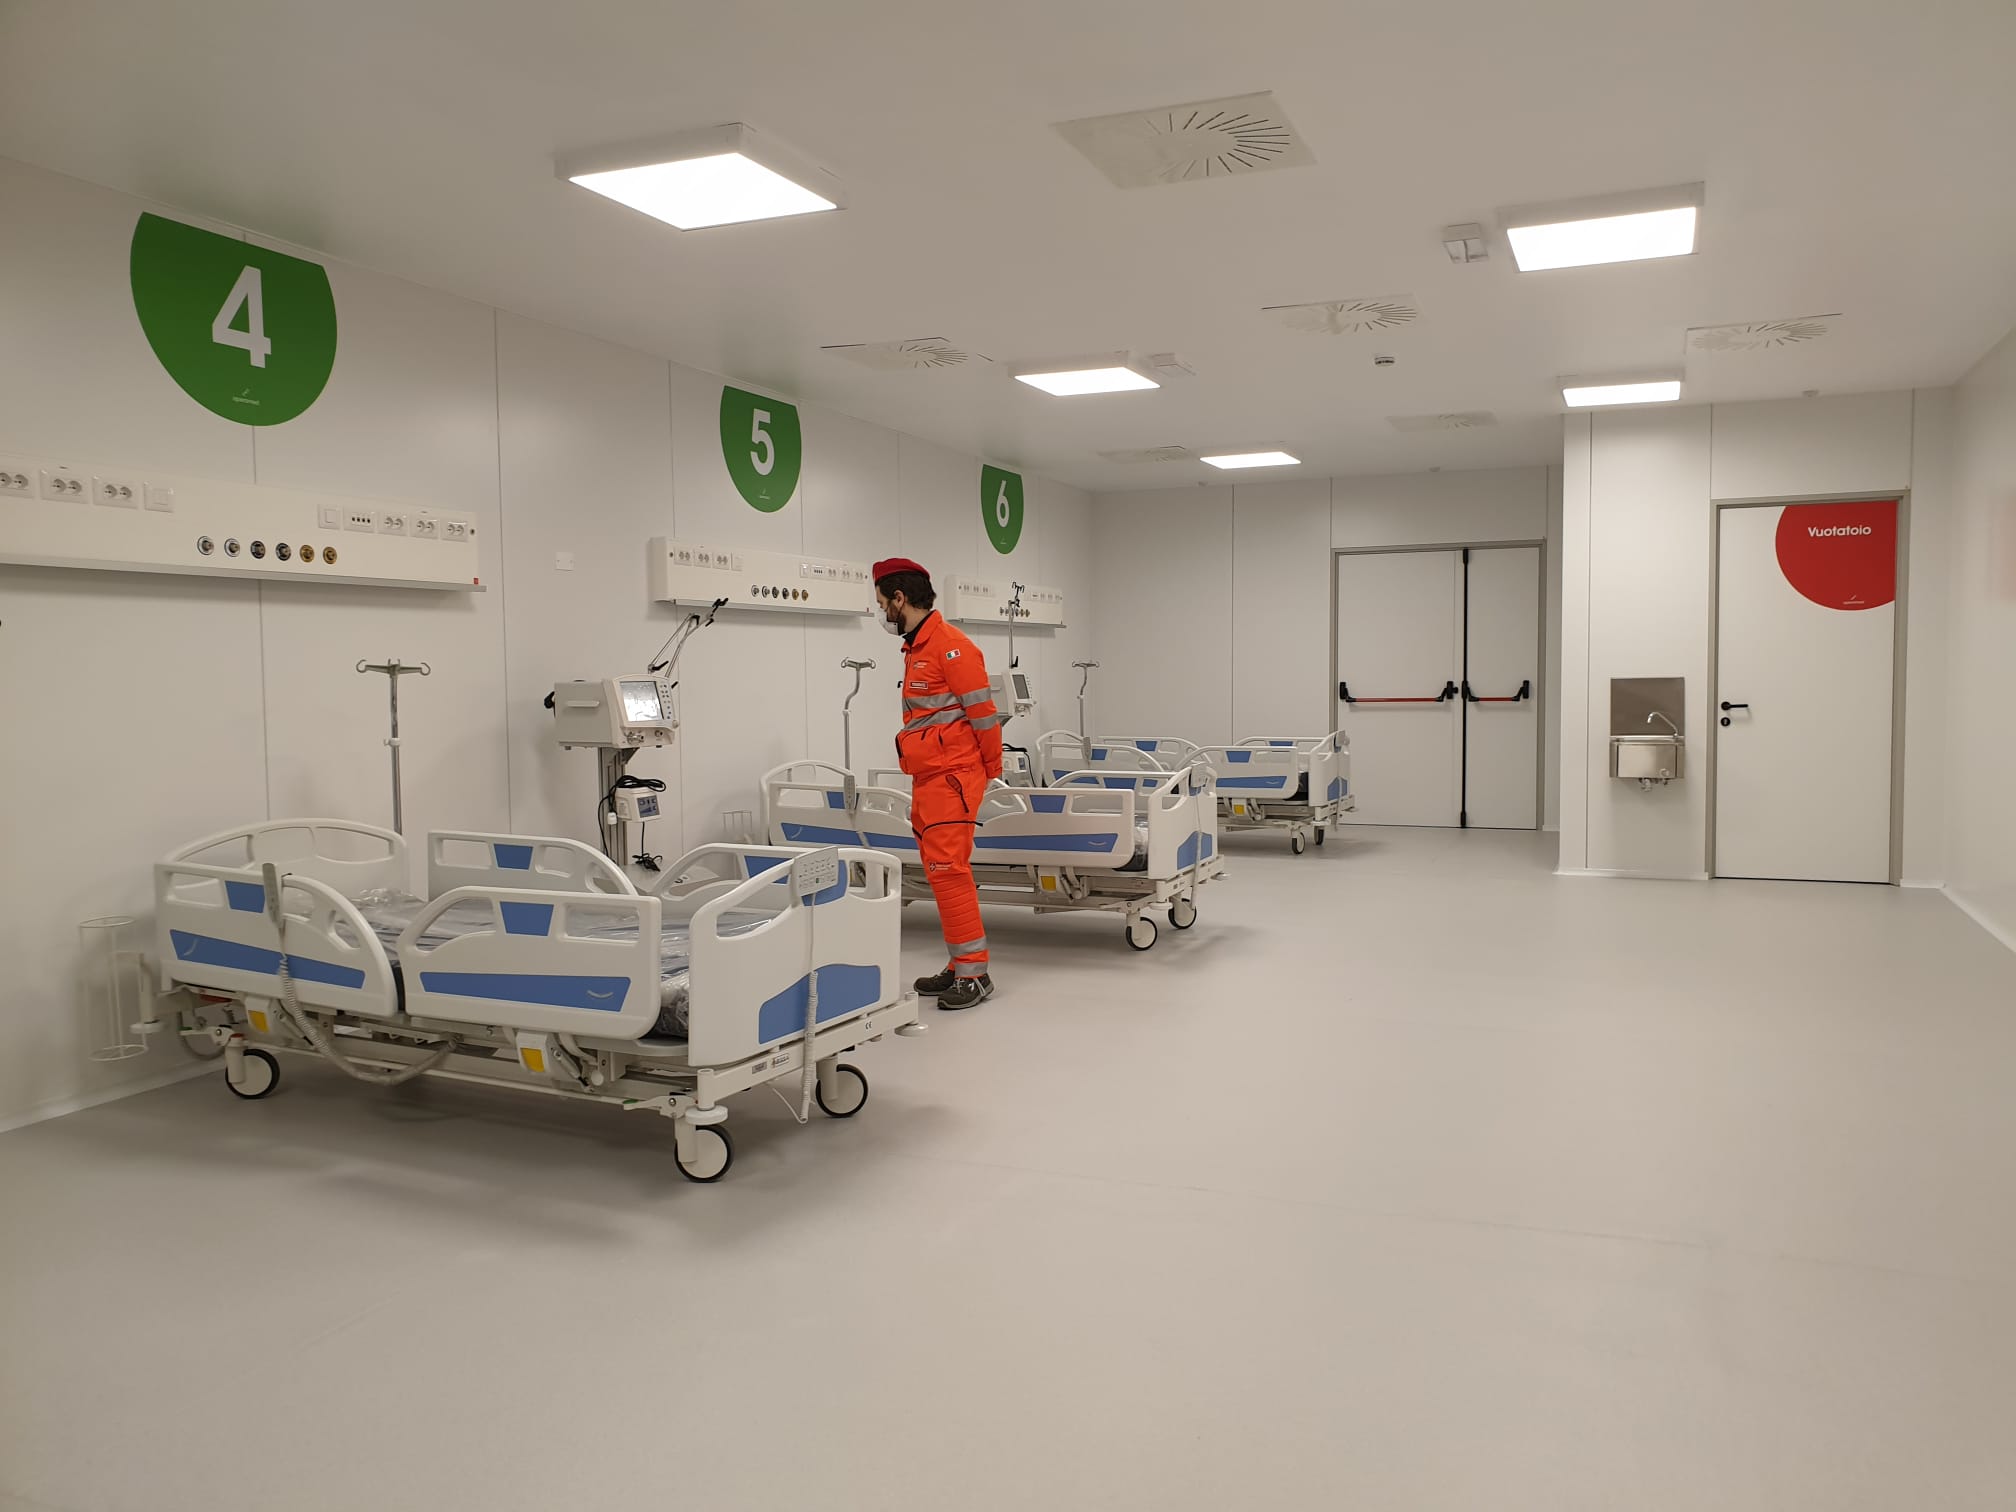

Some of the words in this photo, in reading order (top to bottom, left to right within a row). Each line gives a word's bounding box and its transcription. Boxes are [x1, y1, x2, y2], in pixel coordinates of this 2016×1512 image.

[212, 264, 271, 369] 4
[750, 408, 775, 476] 5
[996, 480, 1010, 528] 6
[1807, 525, 1872, 537] Vuotatoio
